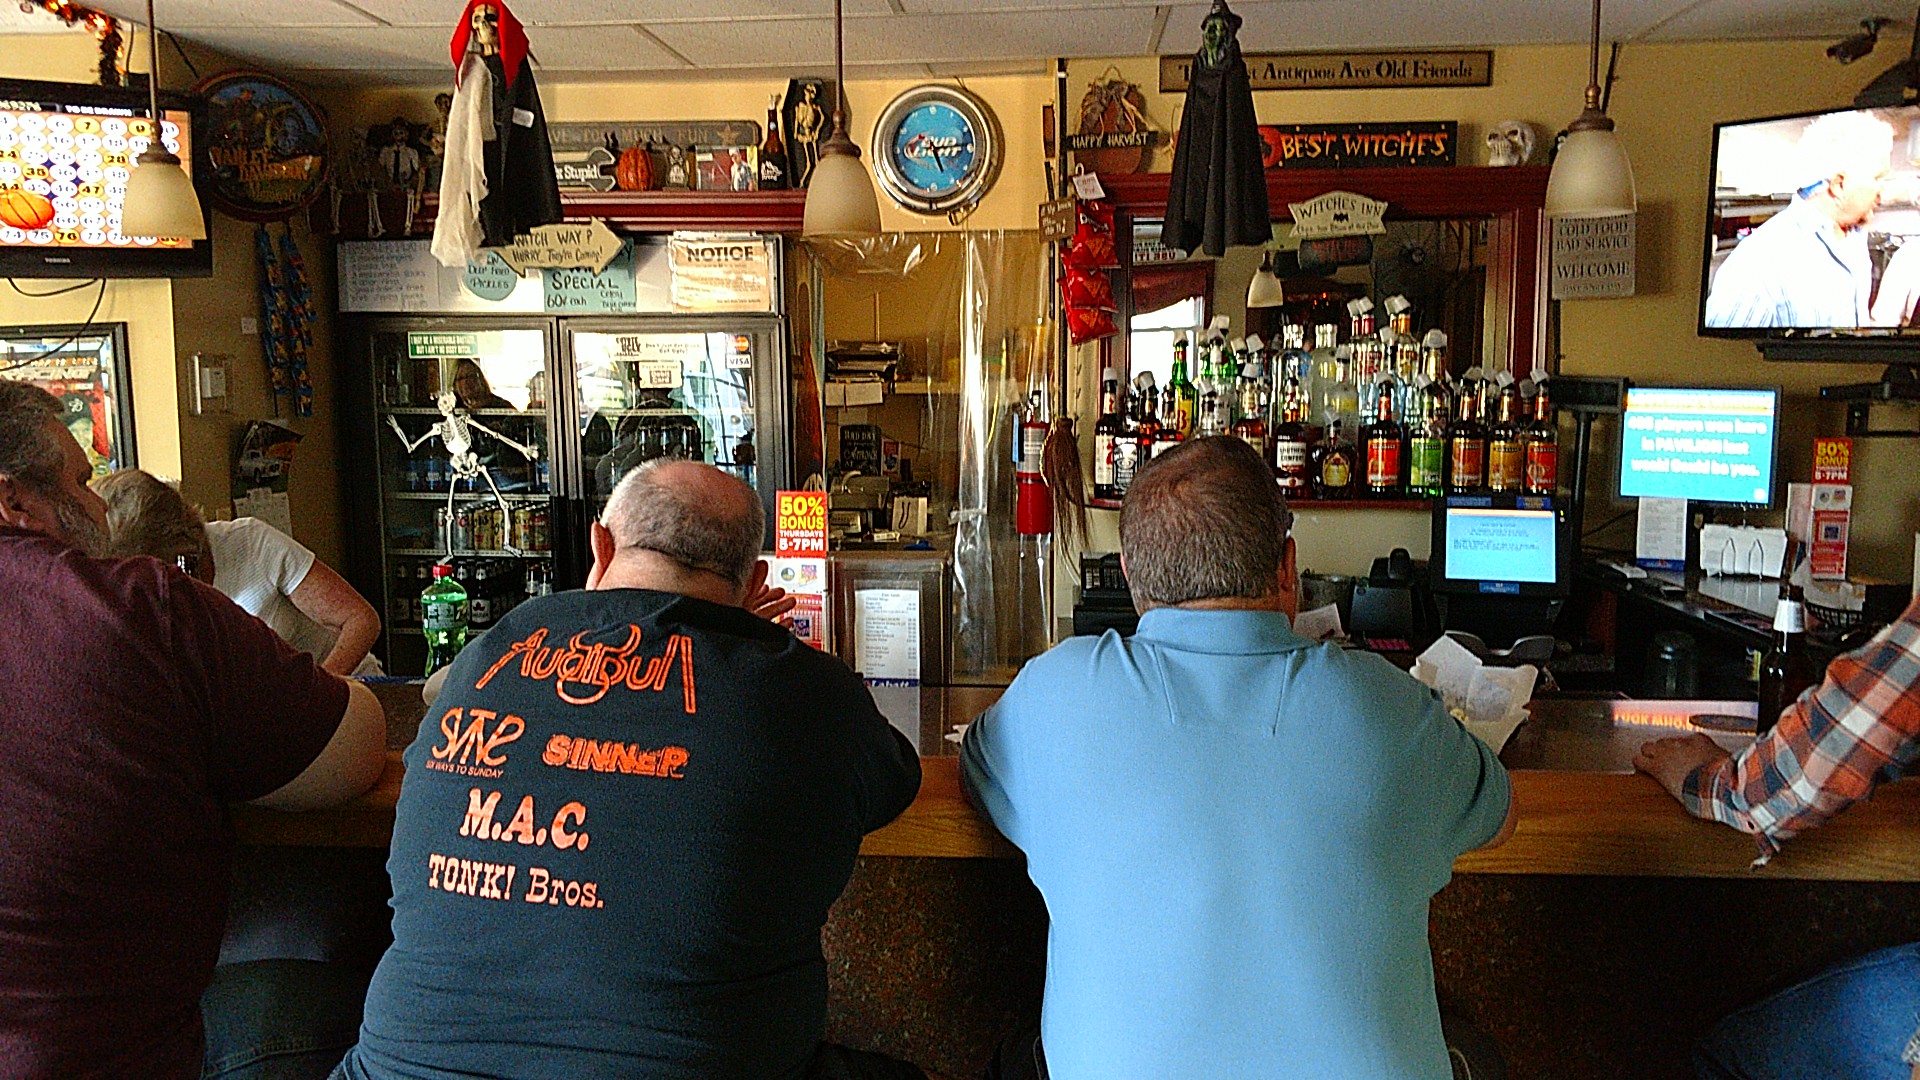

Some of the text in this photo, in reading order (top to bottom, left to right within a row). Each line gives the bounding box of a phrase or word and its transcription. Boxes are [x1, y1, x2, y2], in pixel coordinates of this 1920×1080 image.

[1263, 61, 1335, 84] Antiques
[1340, 61, 1370, 78] Are
[1375, 59, 1407, 78] Old
[1412, 58, 1473, 78] Friends
[621, 127, 663, 143] MUCH
[677, 127, 708, 143] FUN
[920, 136, 957, 147] BUD
[1072, 132, 1149, 149] HAPPY HARVEST
[1280, 129, 1449, 159] BEST WITCHES
[564, 163, 598, 182] Stupid
[1298, 196, 1382, 220] WITCHES INN
[1559, 223, 1590, 237] COLD
[513, 231, 549, 248] WITCH
[1556, 236, 1629, 252] BAD SERVICE
[687, 245, 754, 262] NOTICE
[1556, 261, 1631, 279] WELCOME
[551, 271, 619, 290] SPECIAL
[729, 357, 750, 366] VISA
[1654, 416, 1705, 434] players
[1704, 420, 1734, 434] won
[1734, 417, 1768, 434] here
[1655, 436, 1723, 454] PAVILION
[1817, 441, 1850, 457] 50%
[1670, 458, 1711, 475] Could
[1711, 459, 1731, 475] be
[1816, 455, 1849, 466] BONUS
[780, 496, 825, 516] 50%
[779, 516, 825, 530] BONUS
[779, 529, 824, 538] THURSDAYS
[435, 763, 454, 773] WAYS
[455, 764, 466, 774] TO
[467, 767, 504, 778] SUNDAY
[459, 787, 590, 851] M.A.C.
[428, 853, 605, 909] TONK! Bros.
